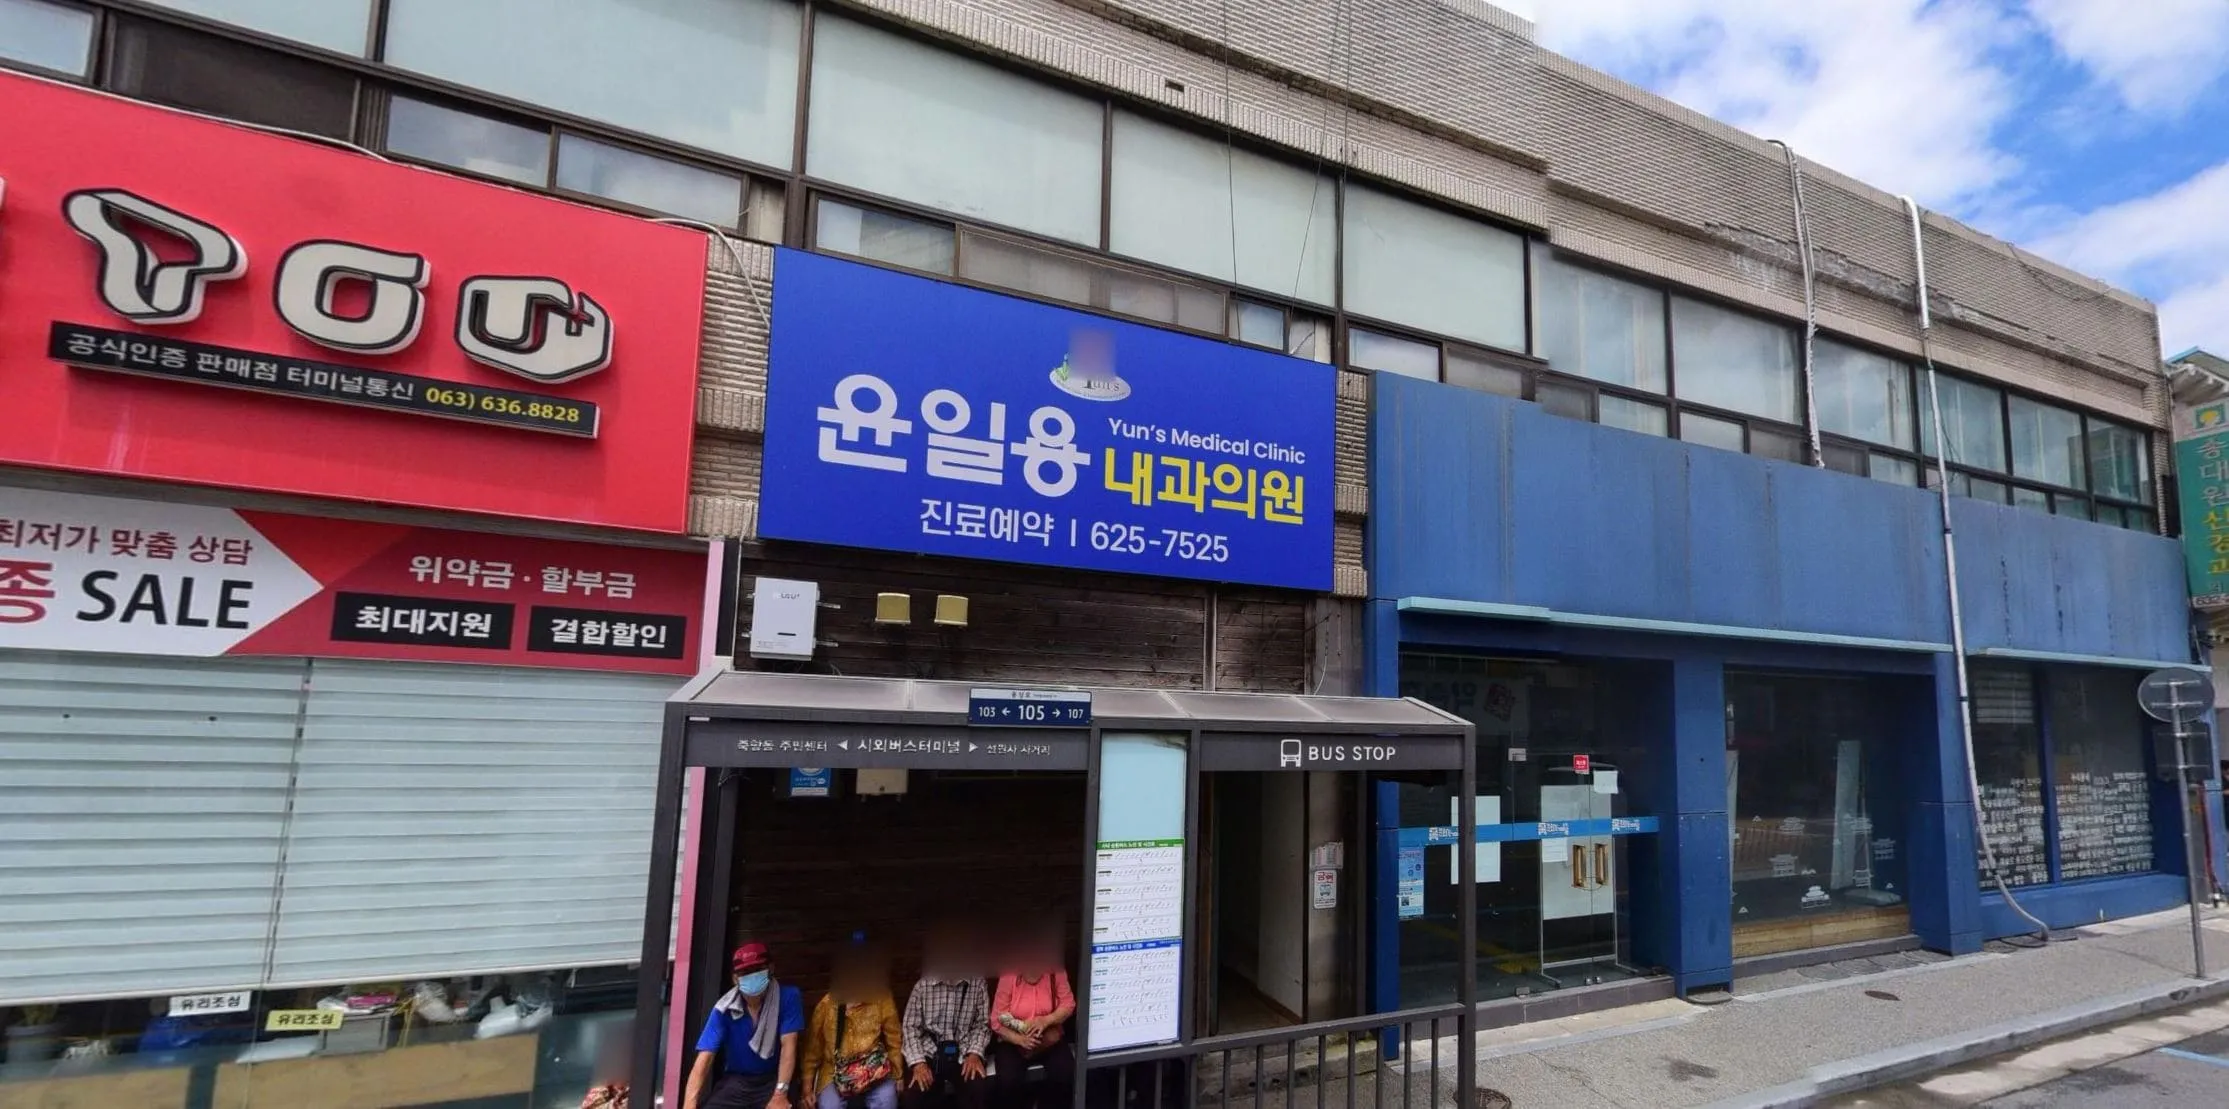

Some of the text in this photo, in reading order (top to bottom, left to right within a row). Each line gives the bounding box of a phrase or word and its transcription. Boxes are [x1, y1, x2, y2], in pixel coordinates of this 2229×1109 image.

[66, 333, 580, 423] 공식인증 판매점 터미널통신 063) 636.8828
[816, 373, 1091, 498] 윤일용
[1107, 416, 1306, 465] Yun's Medical Clinic
[1104, 447, 1305, 525] 내과의원
[0, 519, 253, 566] 최저가 맞춤 상담
[919, 498, 1229, 563] 진료예약 625-7525
[409, 555, 637, 599] 위약금 할부금
[76, 569, 254, 630] SALE
[355, 605, 493, 639] 최대지원
[550, 618, 668, 649] 결합할인
[978, 704, 1084, 721] 103 105 107
[779, 739, 828, 752] 주민센터
[857, 738, 960, 754] 시외버스터미널
[1308, 745, 1396, 761] BUS STOP
[182, 996, 241, 1010] 유리조심
[278, 1013, 335, 1025] 유리조심
